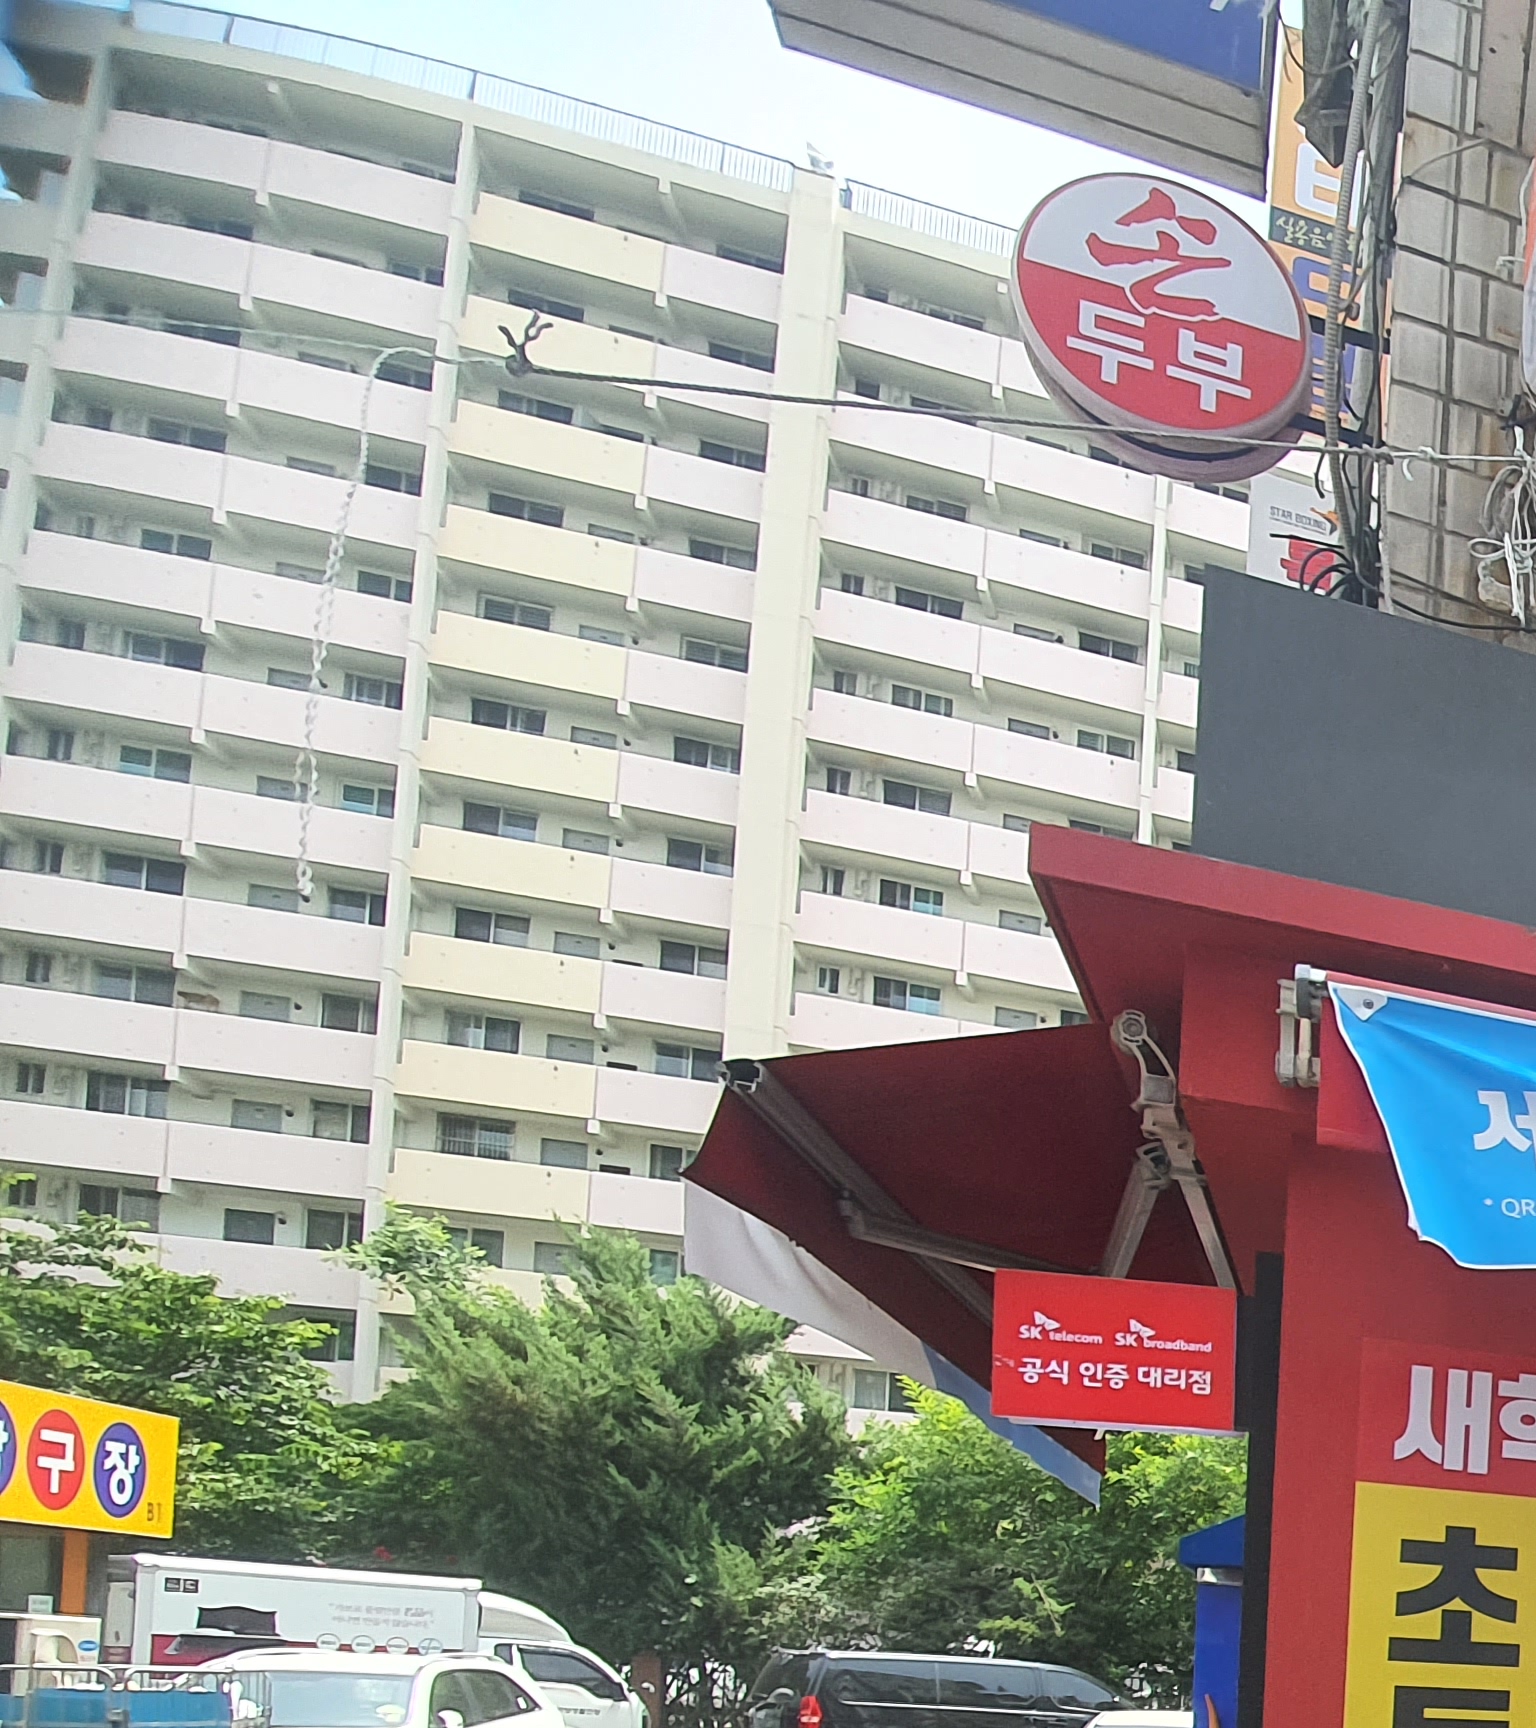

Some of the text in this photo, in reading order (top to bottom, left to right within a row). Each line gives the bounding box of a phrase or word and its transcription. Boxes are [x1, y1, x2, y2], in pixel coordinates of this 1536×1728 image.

[1067, 301, 1252, 413] 두부
[1018, 1325, 1212, 1353] SK telecom SK broadband
[1018, 1357, 1212, 1395] 공식 인증 대리점
[147, 1502, 162, 1522] B1
